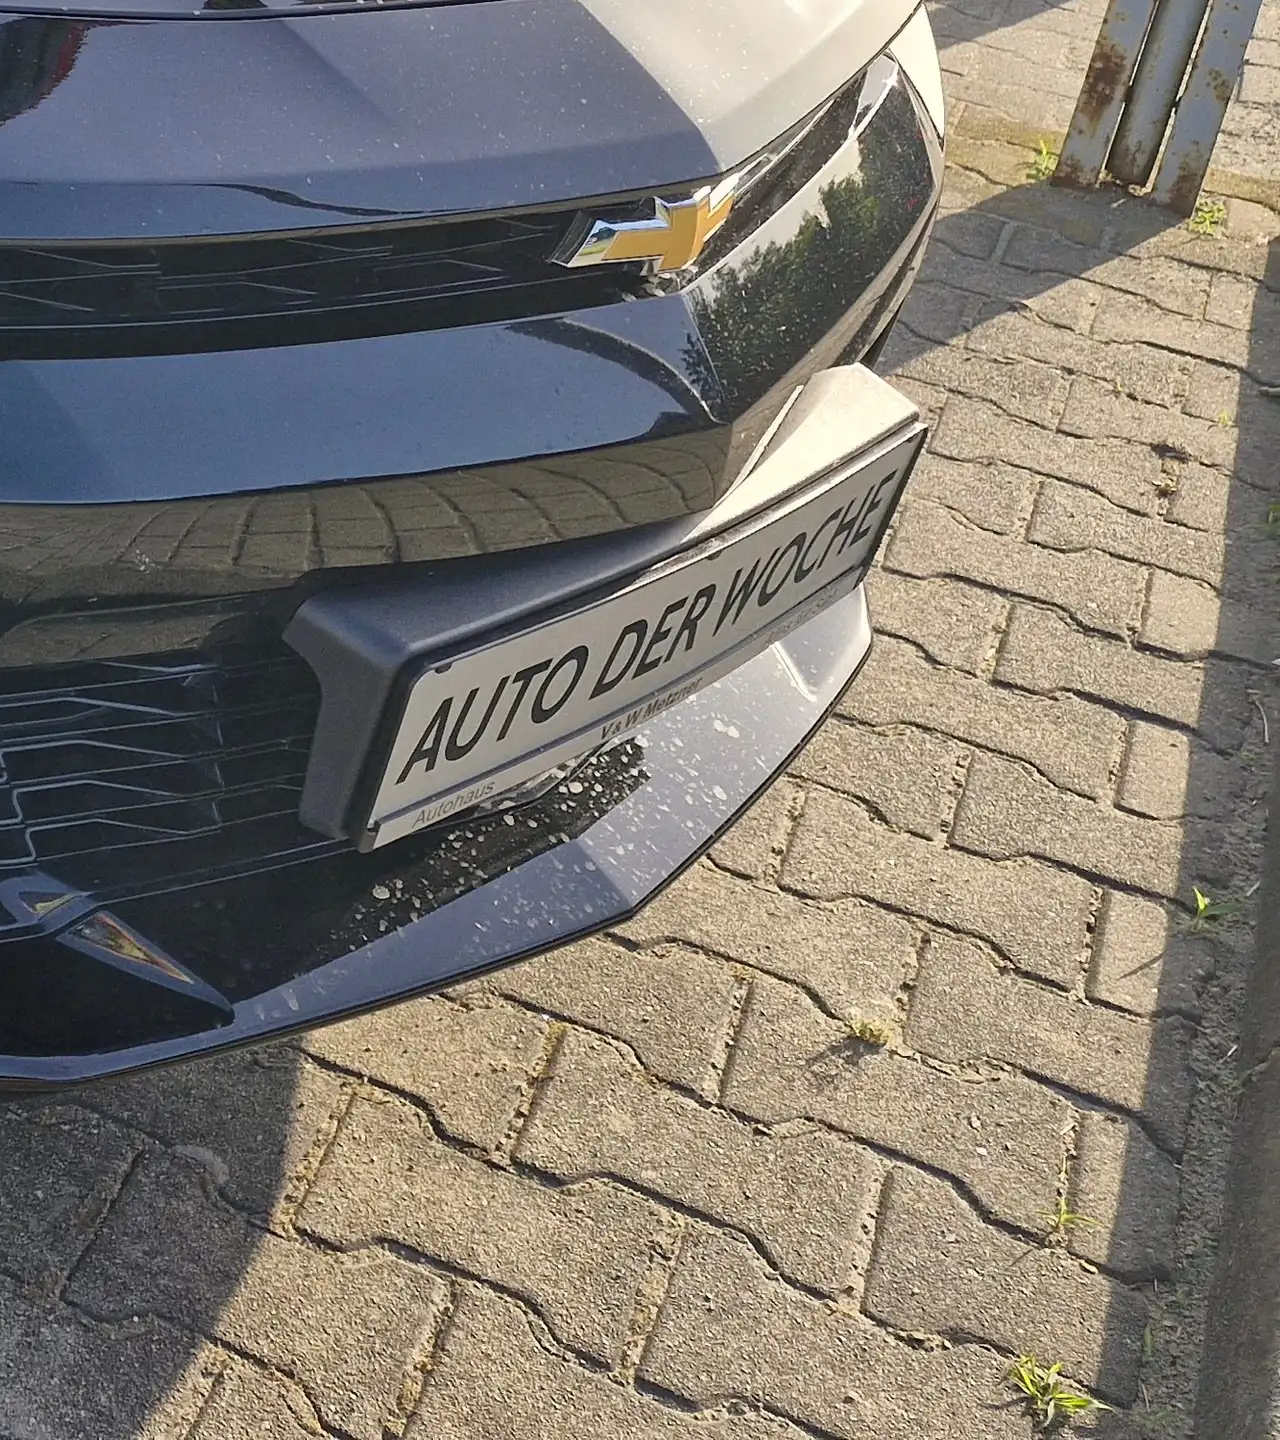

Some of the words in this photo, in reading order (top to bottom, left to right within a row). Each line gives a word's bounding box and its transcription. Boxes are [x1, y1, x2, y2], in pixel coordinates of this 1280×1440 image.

[395, 645, 589, 785] AUTO
[589, 584, 717, 700] DER
[712, 469, 898, 637] WOCHE
[412, 780, 495, 828] Autohaus
[601, 722, 614, 740] V
[625, 707, 644, 728] W
[643, 676, 703, 719] Metzner
